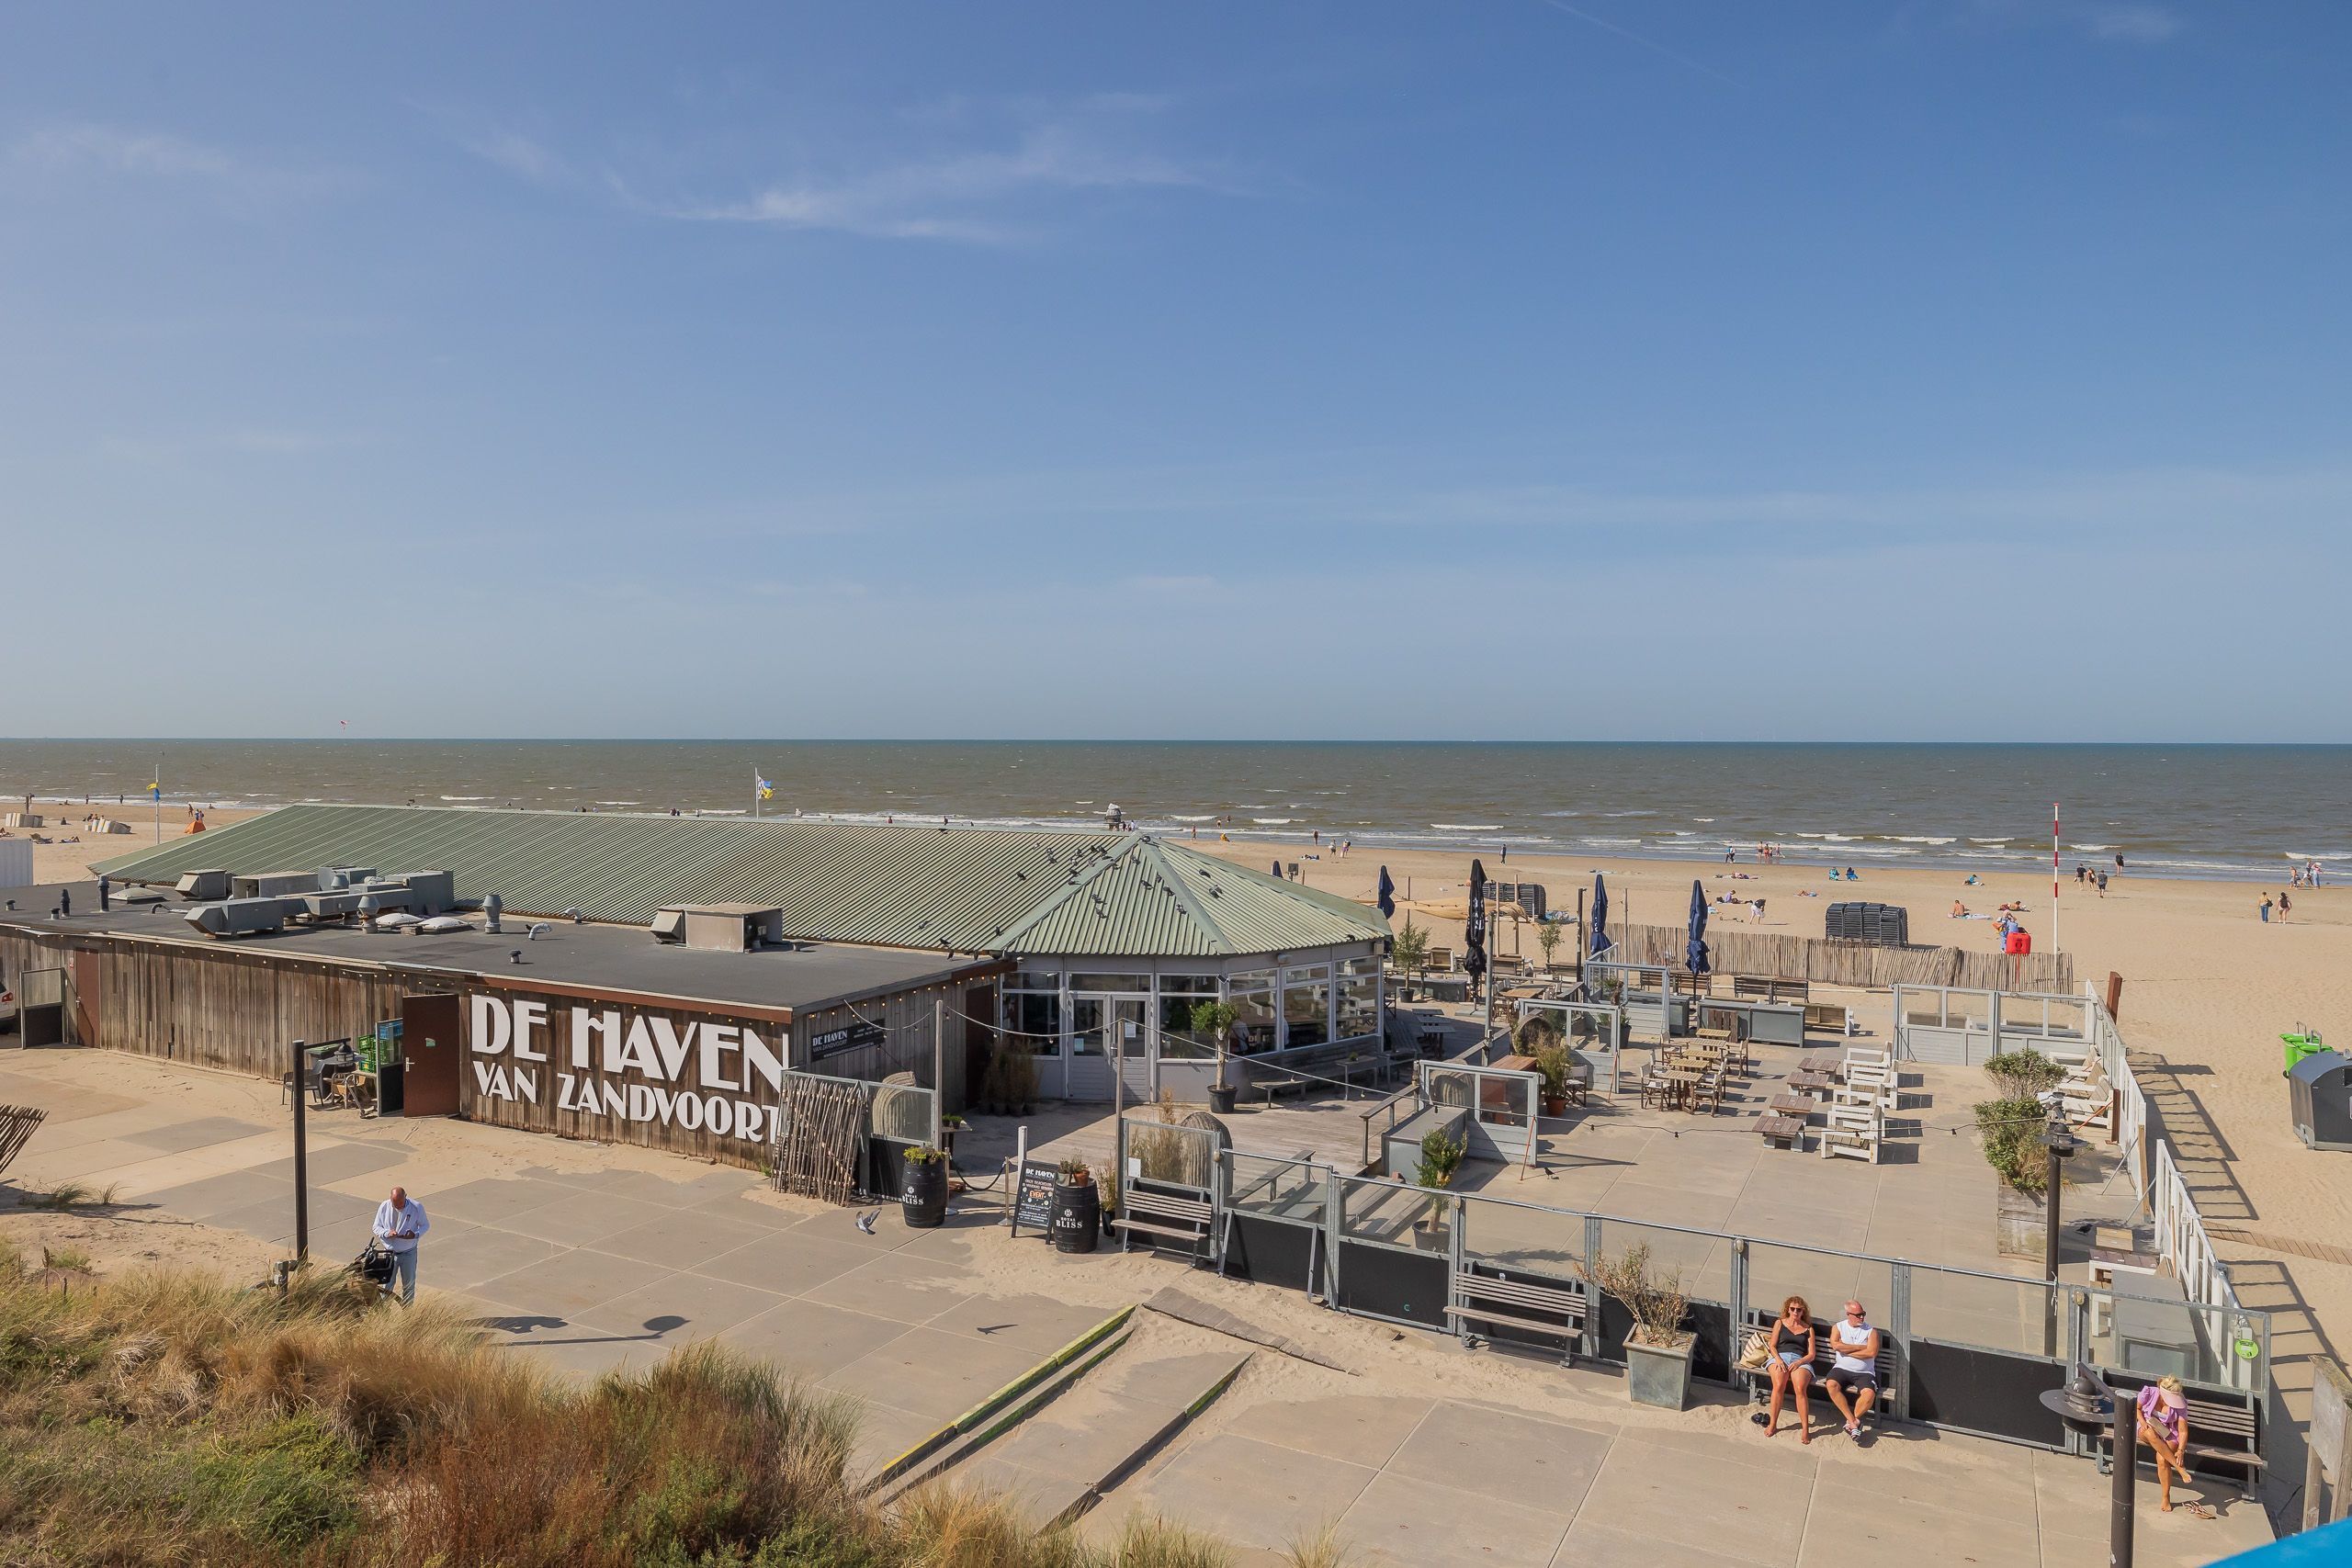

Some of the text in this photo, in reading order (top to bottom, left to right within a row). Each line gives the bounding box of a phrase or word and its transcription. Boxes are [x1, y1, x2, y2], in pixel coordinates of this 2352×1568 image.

[472, 994, 789, 1093] DE HAVEN
[812, 1036, 822, 1046] DE
[824, 1030, 848, 1043] HAVEN
[473, 1061, 780, 1145] VAN ZANDVOORT
[1056, 1219, 1082, 1228] BLISS
